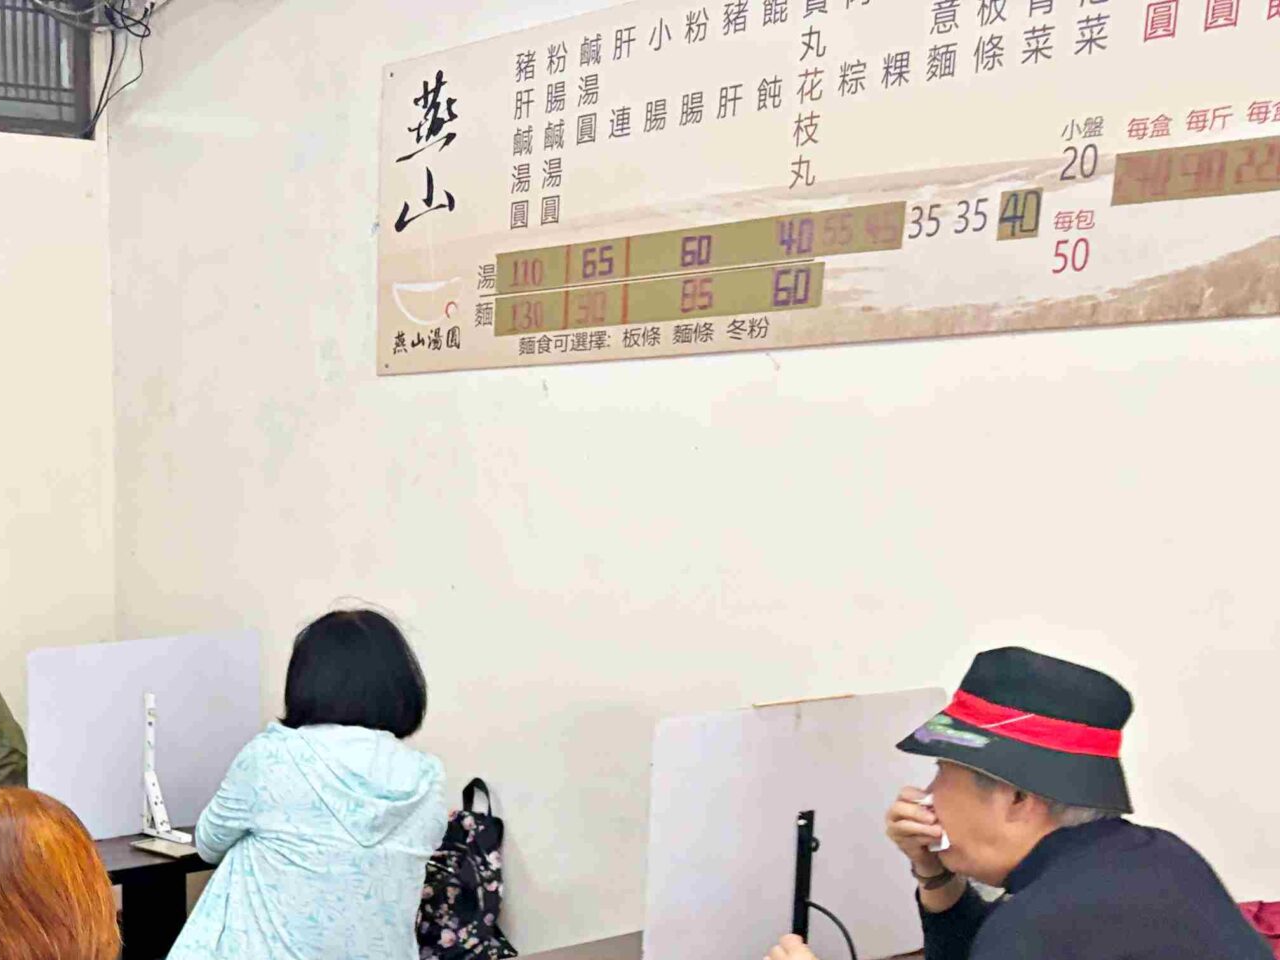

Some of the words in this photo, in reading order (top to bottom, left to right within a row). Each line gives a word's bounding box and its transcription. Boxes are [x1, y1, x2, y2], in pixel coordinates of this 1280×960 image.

[608, 26, 637, 139] 肝連
[643, 17, 672, 133] 小腸
[679, 7, 710, 126] 粉腸
[716, 0, 749, 120] 豬肝
[757, 0, 789, 111] 餛飩
[837, 0, 871, 97] 粽
[926, 0, 960, 82] 意麵
[973, 0, 1007, 74] 板條
[540, 41, 568, 226] 粉腸鹹湯圓
[576, 33, 602, 146] 鹹湯圓
[1061, 116, 1104, 141] 小盤
[1127, 114, 1173, 140] 每盒
[1186, 105, 1234, 132] 每斤
[395, 69, 458, 233] 燕山
[510, 50, 536, 230] 豬肝鹹湯圓
[1059, 143, 1098, 181] 20
[477, 264, 495, 290] 湯
[581, 245, 614, 279] 65
[680, 235, 712, 267] 60
[777, 218, 815, 255] 40
[908, 204, 941, 239] 35
[954, 198, 988, 234] 35
[999, 190, 1041, 237] 40
[1052, 238, 1090, 274] 50
[1054, 210, 1096, 232] 每包
[622, 327, 661, 348] 板條
[672, 322, 714, 344] 麵條
[726, 316, 770, 340] 冬粉
[773, 269, 811, 306] 60
